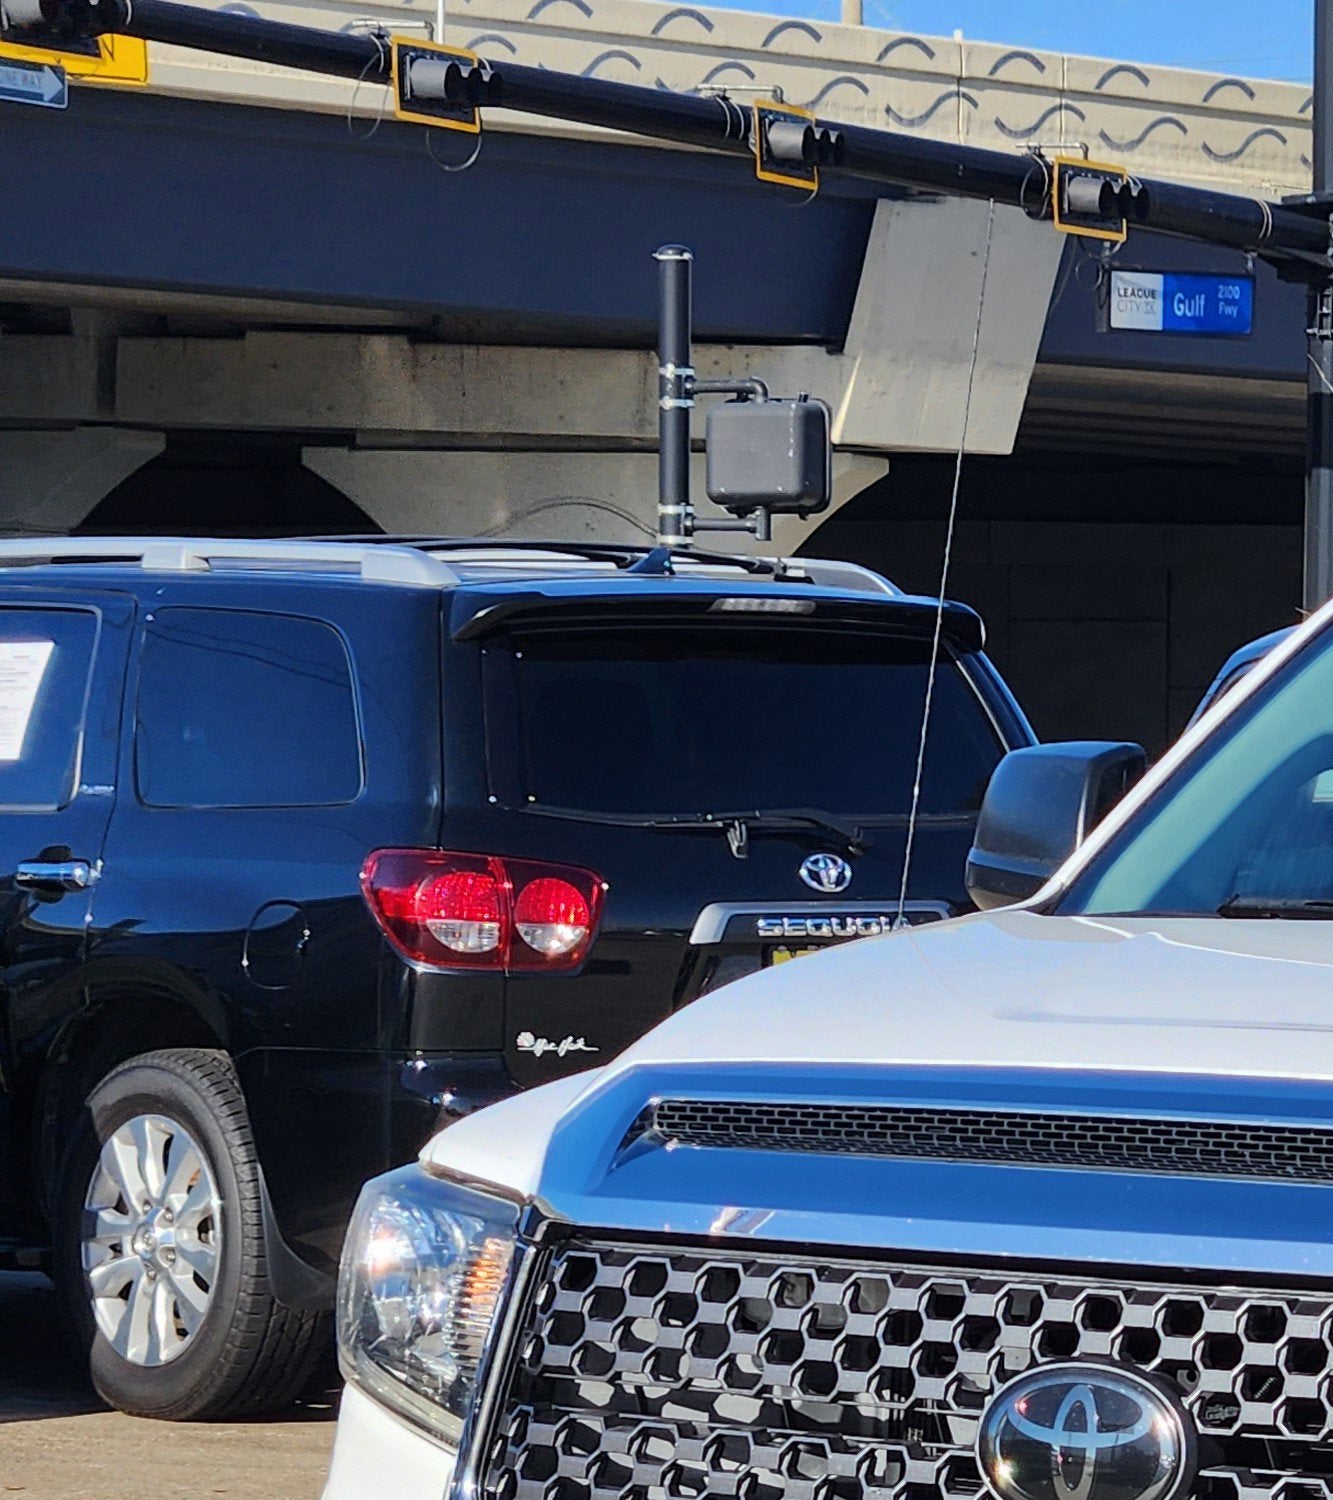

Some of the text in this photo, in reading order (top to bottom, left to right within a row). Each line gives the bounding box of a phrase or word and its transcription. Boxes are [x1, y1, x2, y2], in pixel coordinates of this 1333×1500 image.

[1117, 287, 1157, 300] LEAGUE
[1218, 284, 1240, 300] 2100
[1116, 300, 1142, 313] CITY
[1173, 292, 1206, 318] Gulf
[1218, 301, 1238, 318] Fwy
